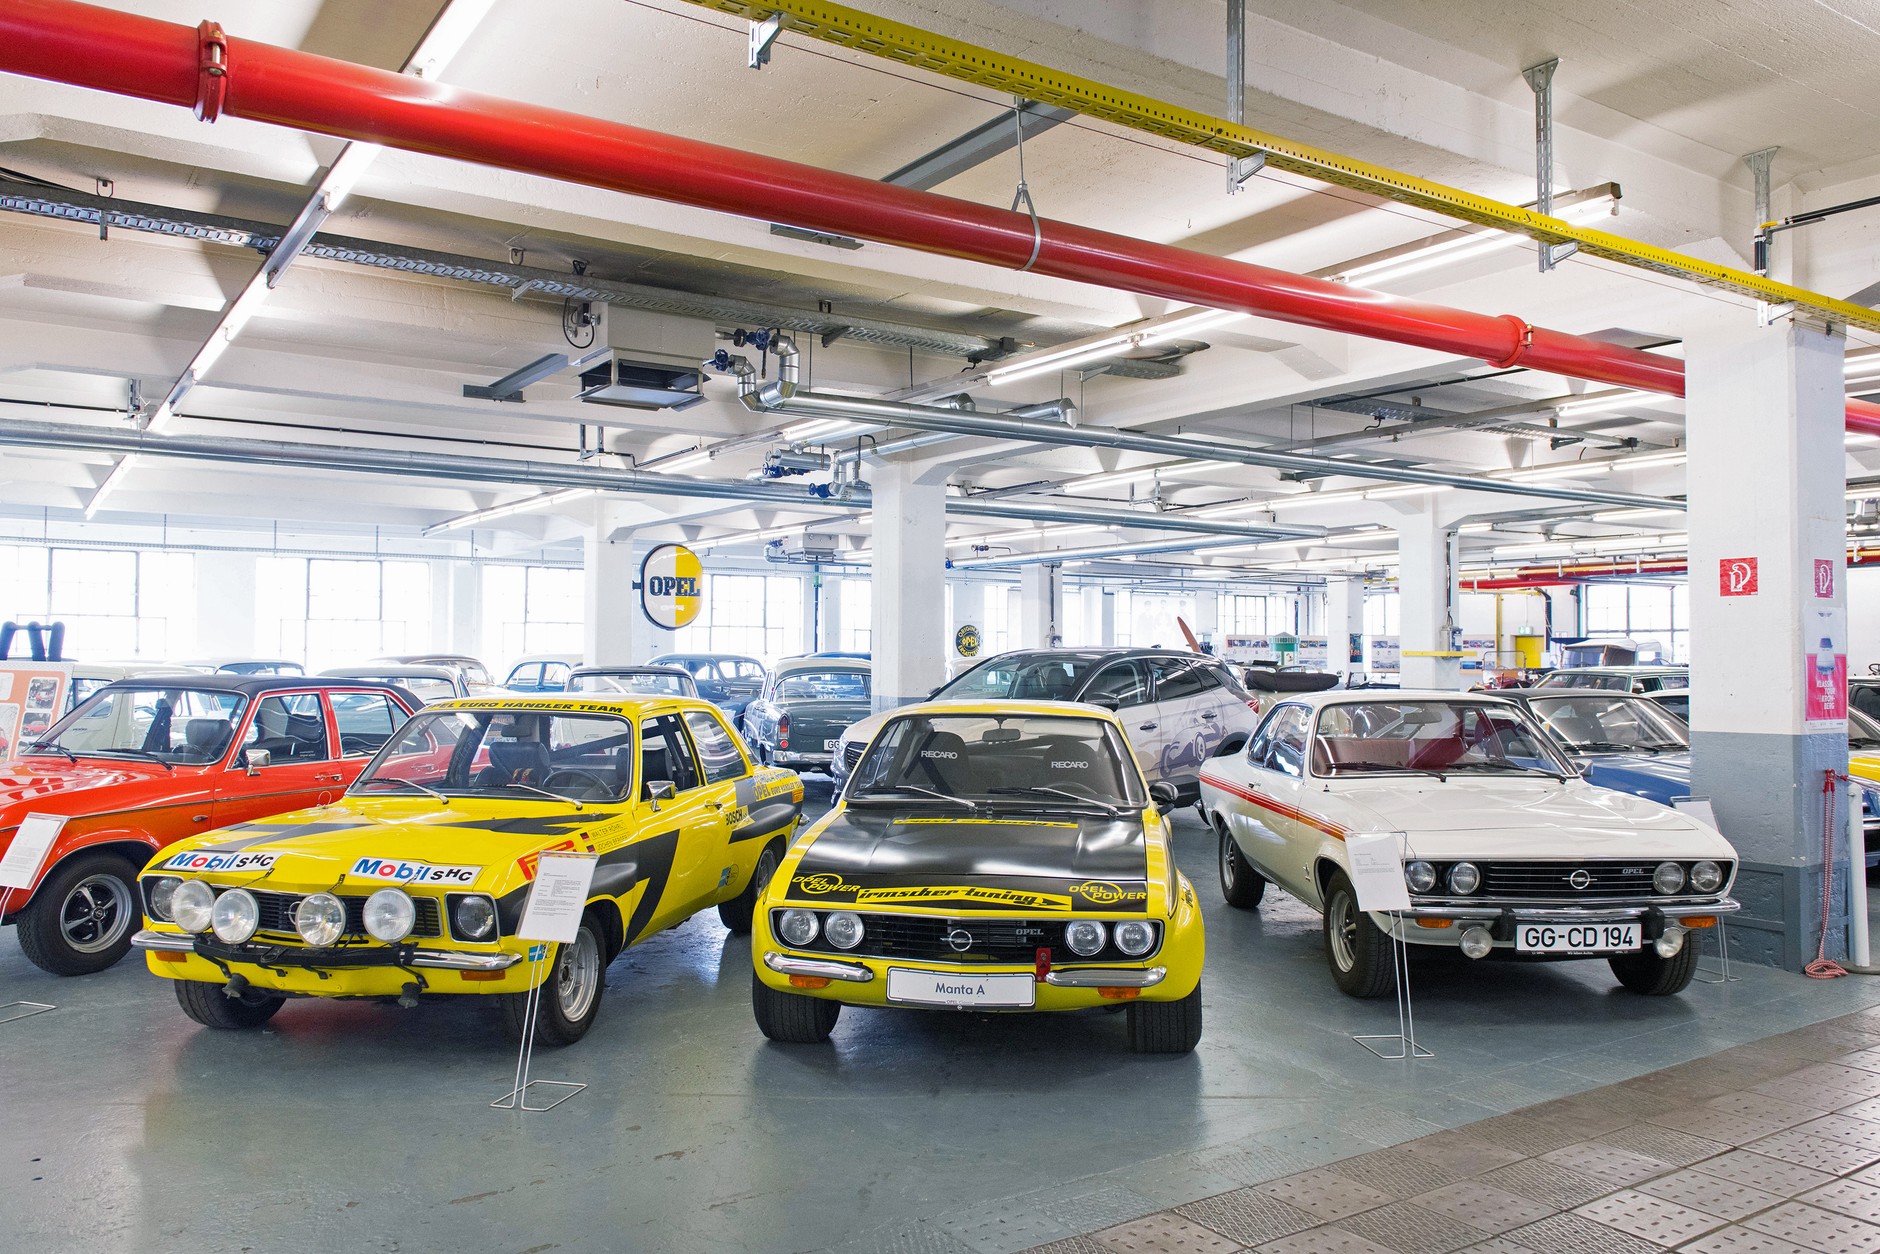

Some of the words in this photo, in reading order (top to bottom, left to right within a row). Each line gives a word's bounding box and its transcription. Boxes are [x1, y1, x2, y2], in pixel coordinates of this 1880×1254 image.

[649, 575, 700, 597] OPEL
[502, 701, 574, 709] HÄNDLER
[579, 704, 624, 713] TEAM
[920, 750, 958, 760] RECARO
[1051, 761, 1089, 769] RECARO
[725, 808, 743, 826] BOSCH
[170, 851, 238, 869] Mobil
[353, 857, 433, 881] Mobil
[792, 876, 828, 884] OPEL
[807, 883, 861, 892] POWER
[1068, 885, 1107, 893] OPEL
[1525, 927, 1598, 948] GG-CD
[1602, 926, 1633, 947] 194
[935, 982, 973, 995] Manta
[976, 984, 985, 995] A
